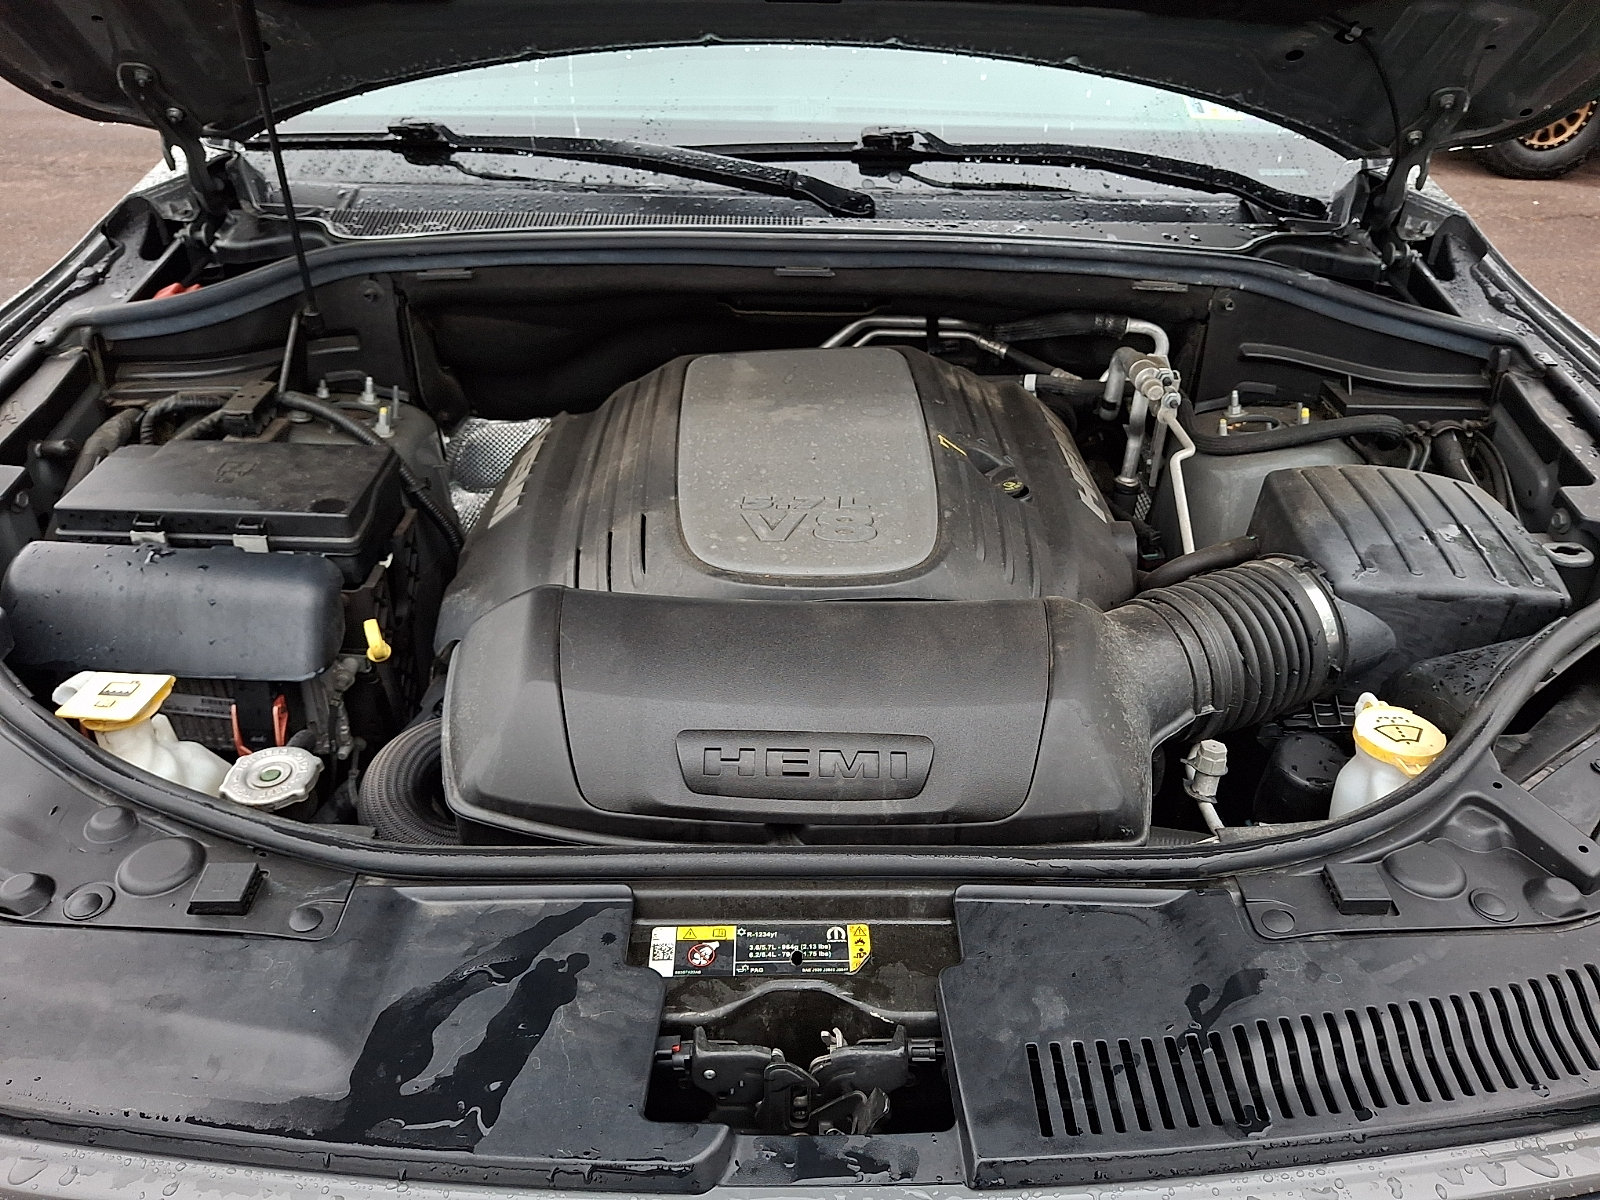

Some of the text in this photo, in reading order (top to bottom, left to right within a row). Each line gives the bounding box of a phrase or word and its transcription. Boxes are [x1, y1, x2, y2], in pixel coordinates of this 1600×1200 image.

[740, 511, 878, 543] V8
[702, 747, 908, 779] HEMI
[746, 931, 778, 939] R-1234yf
